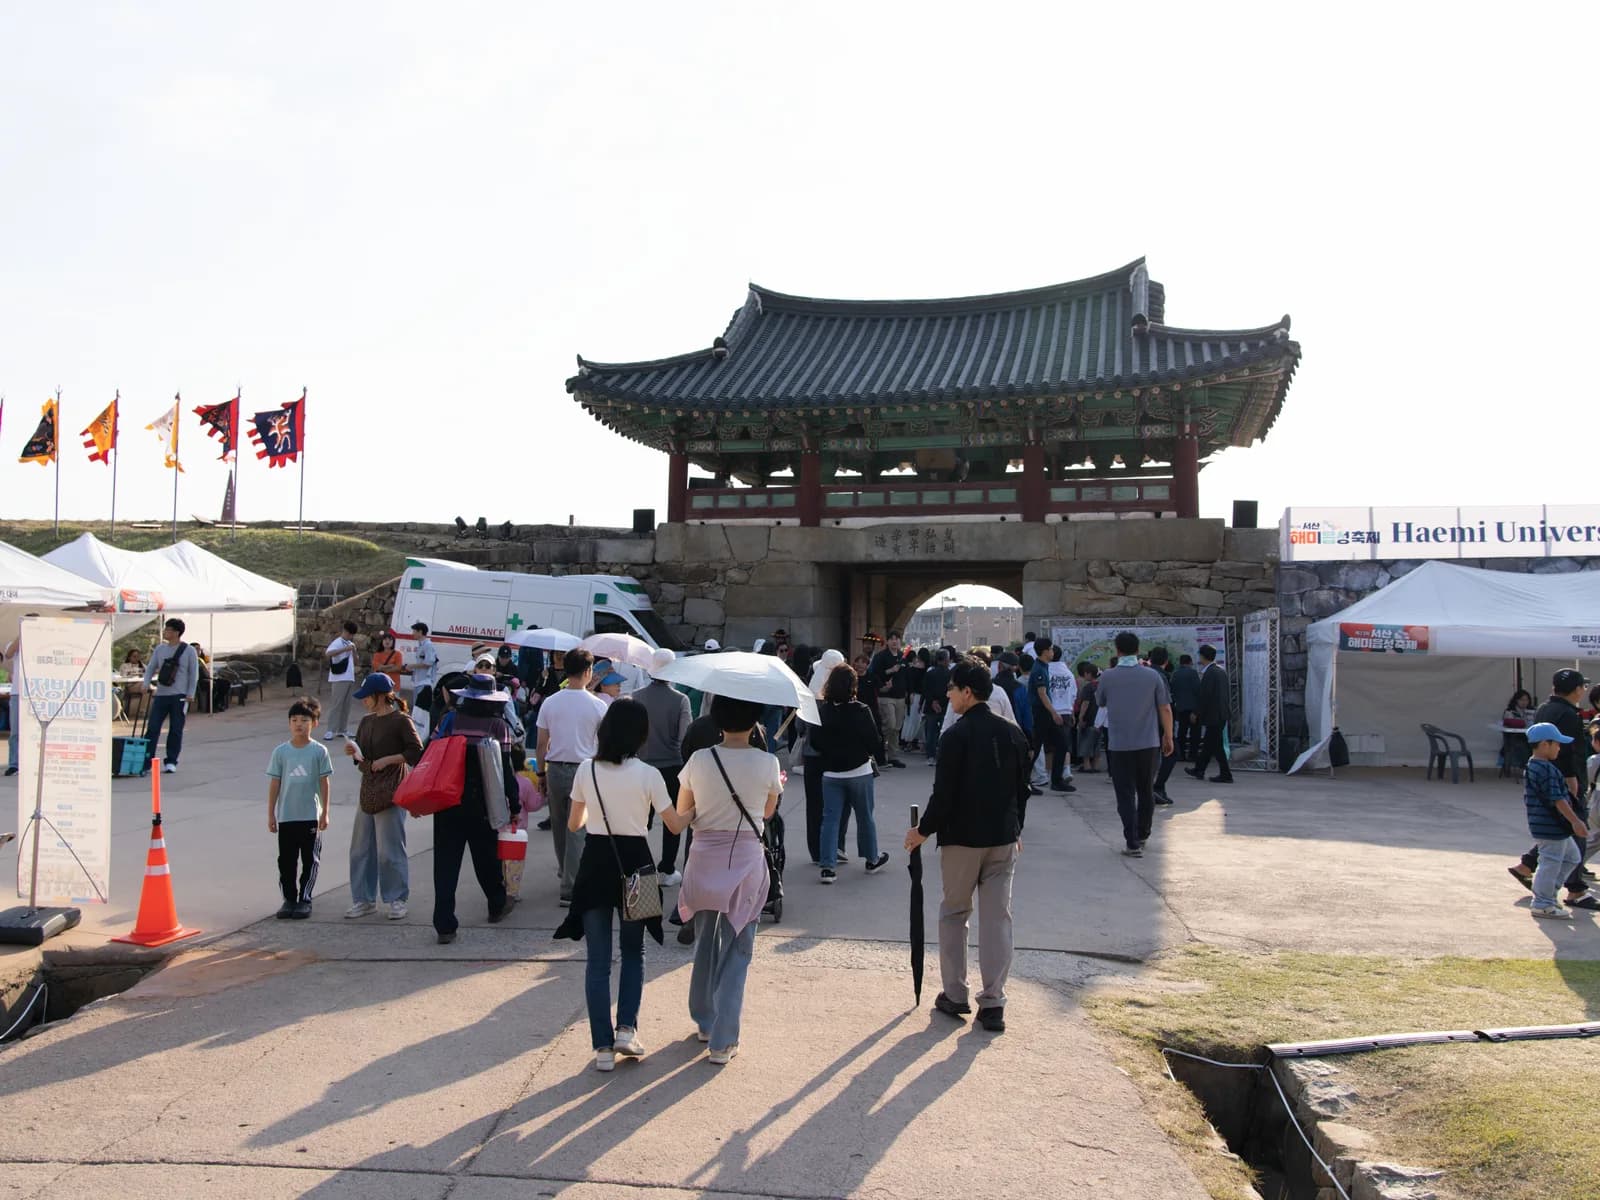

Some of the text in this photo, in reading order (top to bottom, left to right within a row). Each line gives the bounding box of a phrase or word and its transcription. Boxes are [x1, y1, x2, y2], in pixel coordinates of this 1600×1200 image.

[1303, 521, 1320, 530] 서산
[1392, 520, 1488, 543] Haemi
[447, 624, 505, 637] AMBULANCE
